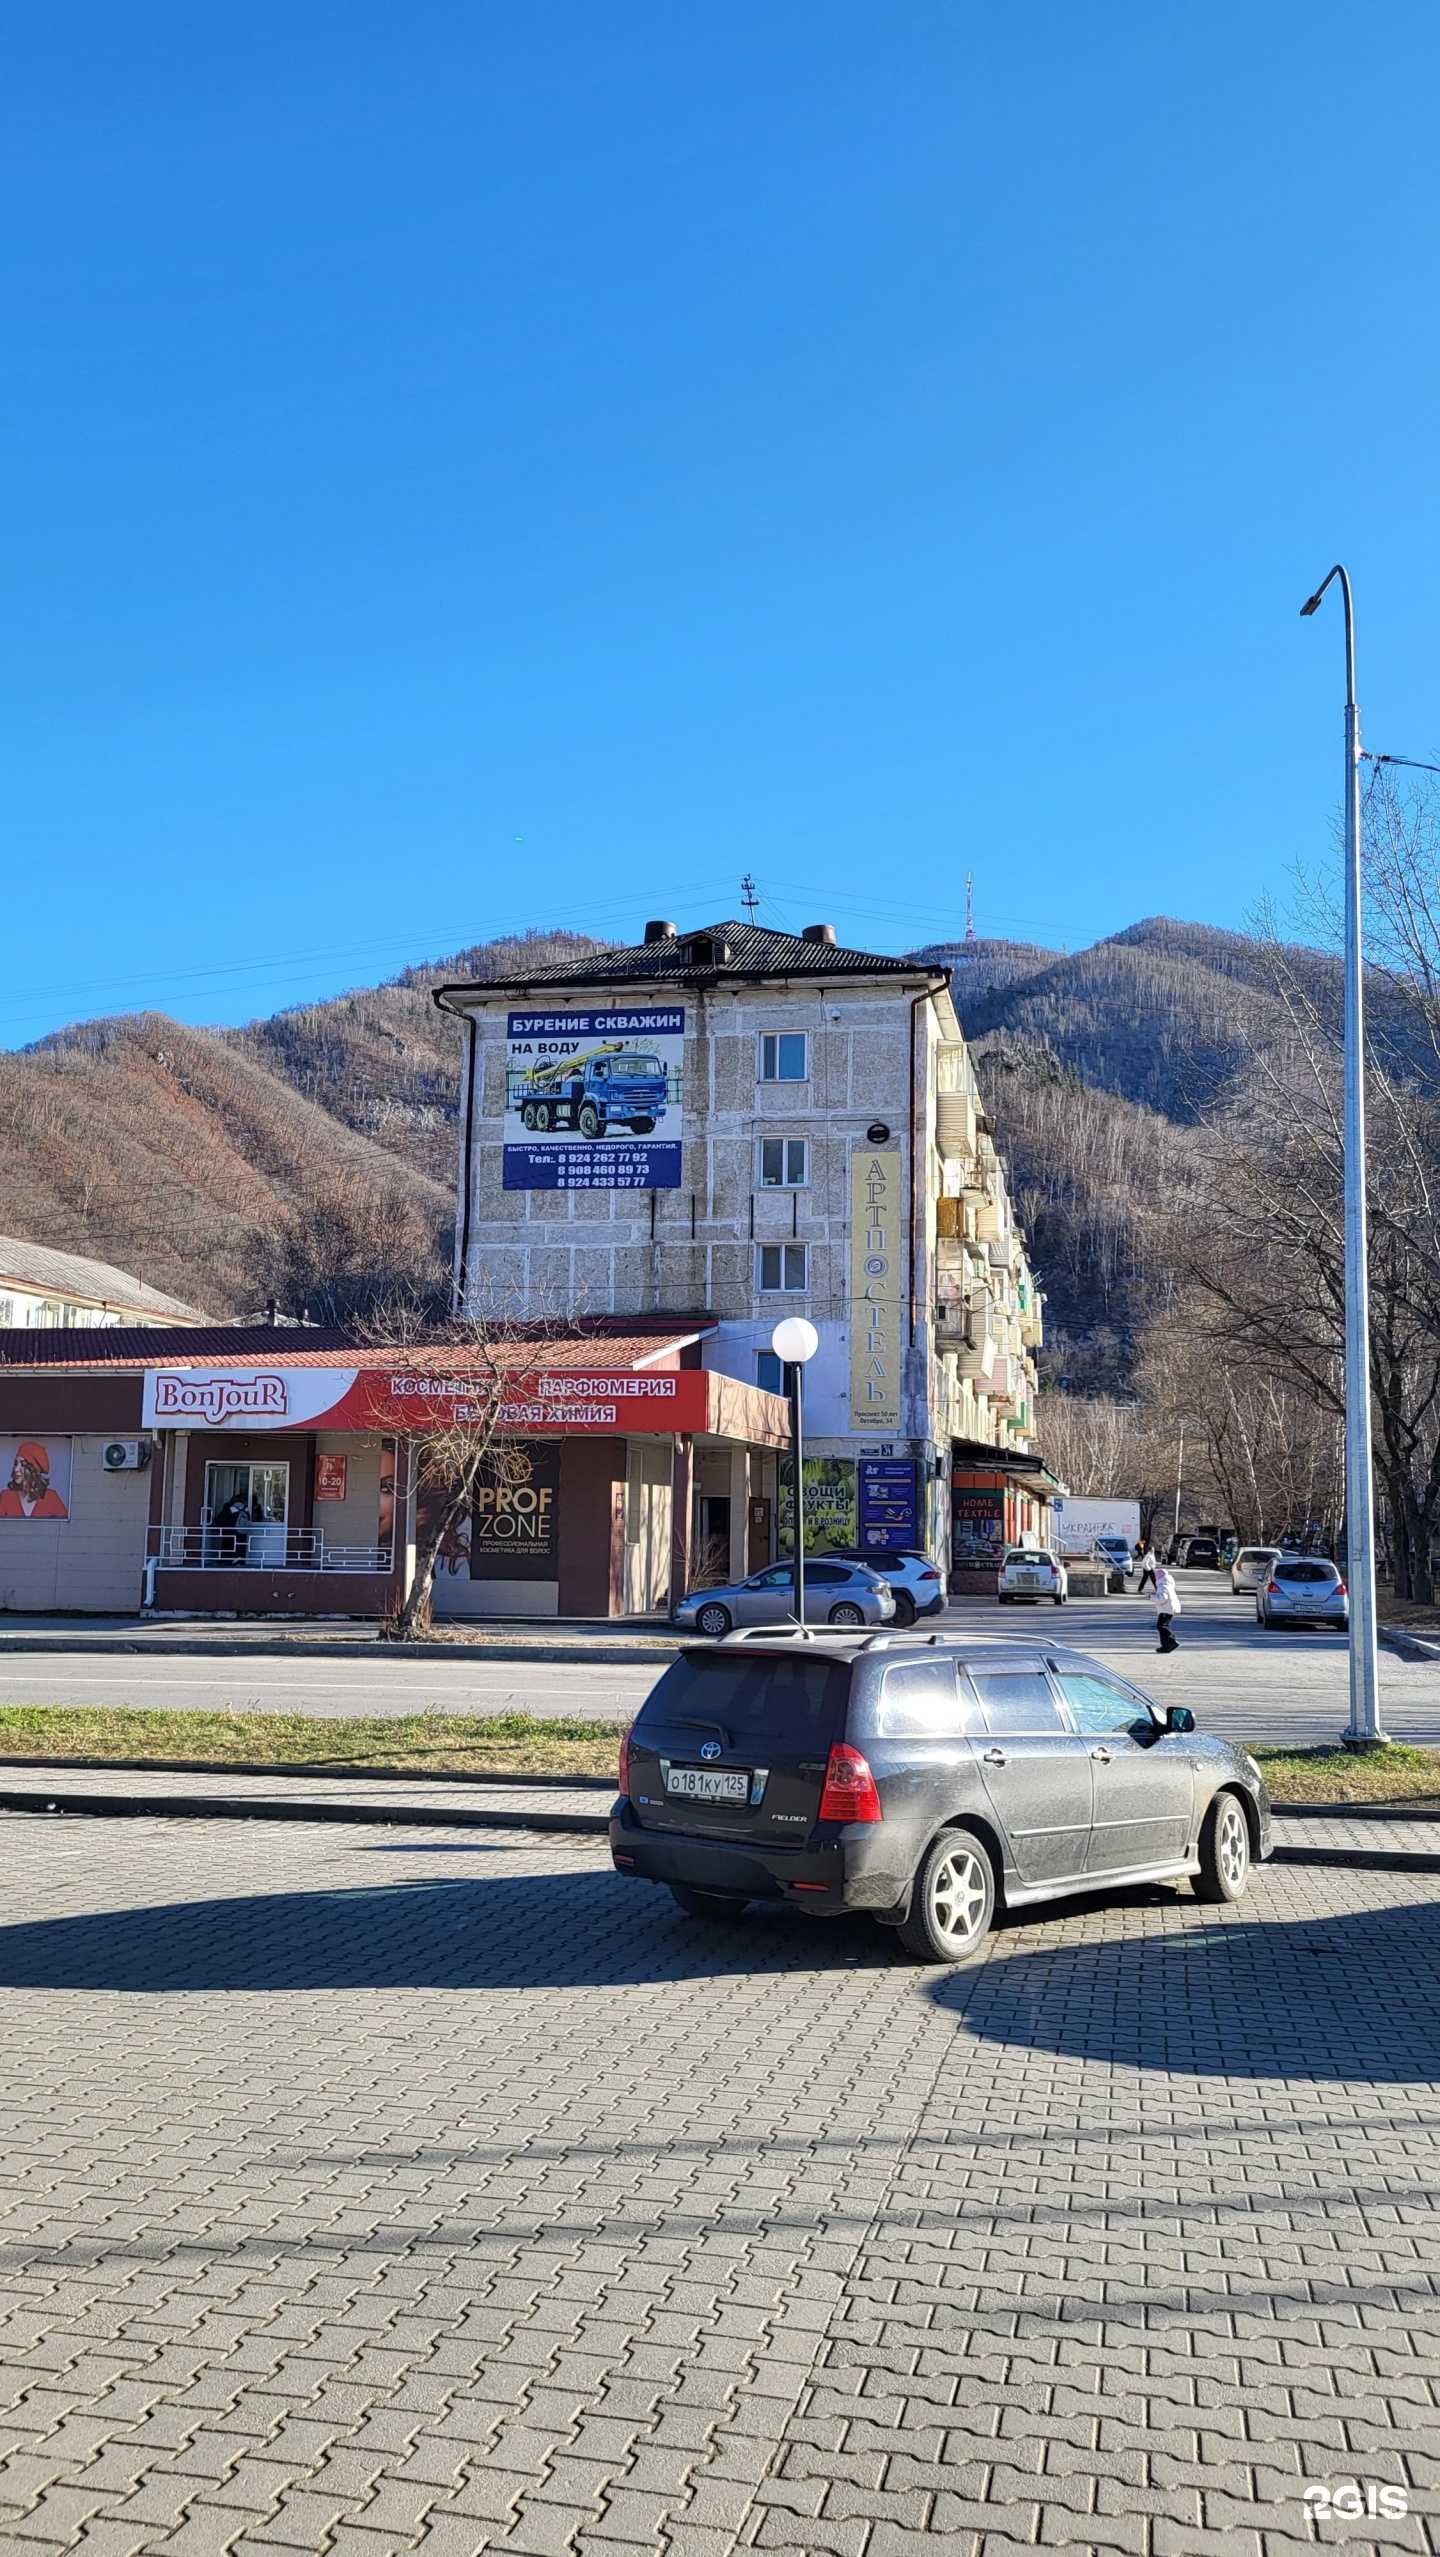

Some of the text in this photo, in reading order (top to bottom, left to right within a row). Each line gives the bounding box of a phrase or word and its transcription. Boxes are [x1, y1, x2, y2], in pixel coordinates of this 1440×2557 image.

[512, 1015, 681, 1032] БУРЕНИЕ СКВАЖИН
[511, 1042, 579, 1054] НА ВОДУ
[558, 1154, 566, 1163] 8
[568, 1154, 591, 1163] 924
[593, 1153, 615, 1163] 262
[618, 1153, 630, 1162] 77
[632, 1153, 648, 1162] 92
[558, 1165, 650, 1176] 8 908 460 89 73
[557, 1177, 646, 1187] 8 924 433 57 77
[391, 1378, 676, 1396] КОСМЕТИ ПАРФЮМЕРИЯ
[454, 1405, 616, 1422] БЫОВАЯ ХИМИЯ
[479, 1488, 552, 1513] PROF
[785, 1500, 849, 1511] ФУКТЫ
[962, 1499, 994, 1508] HOME
[479, 1514, 551, 1537] ZONE
[724, 1776, 744, 1791] 125
[771, 1814, 808, 1823] FIELDER
